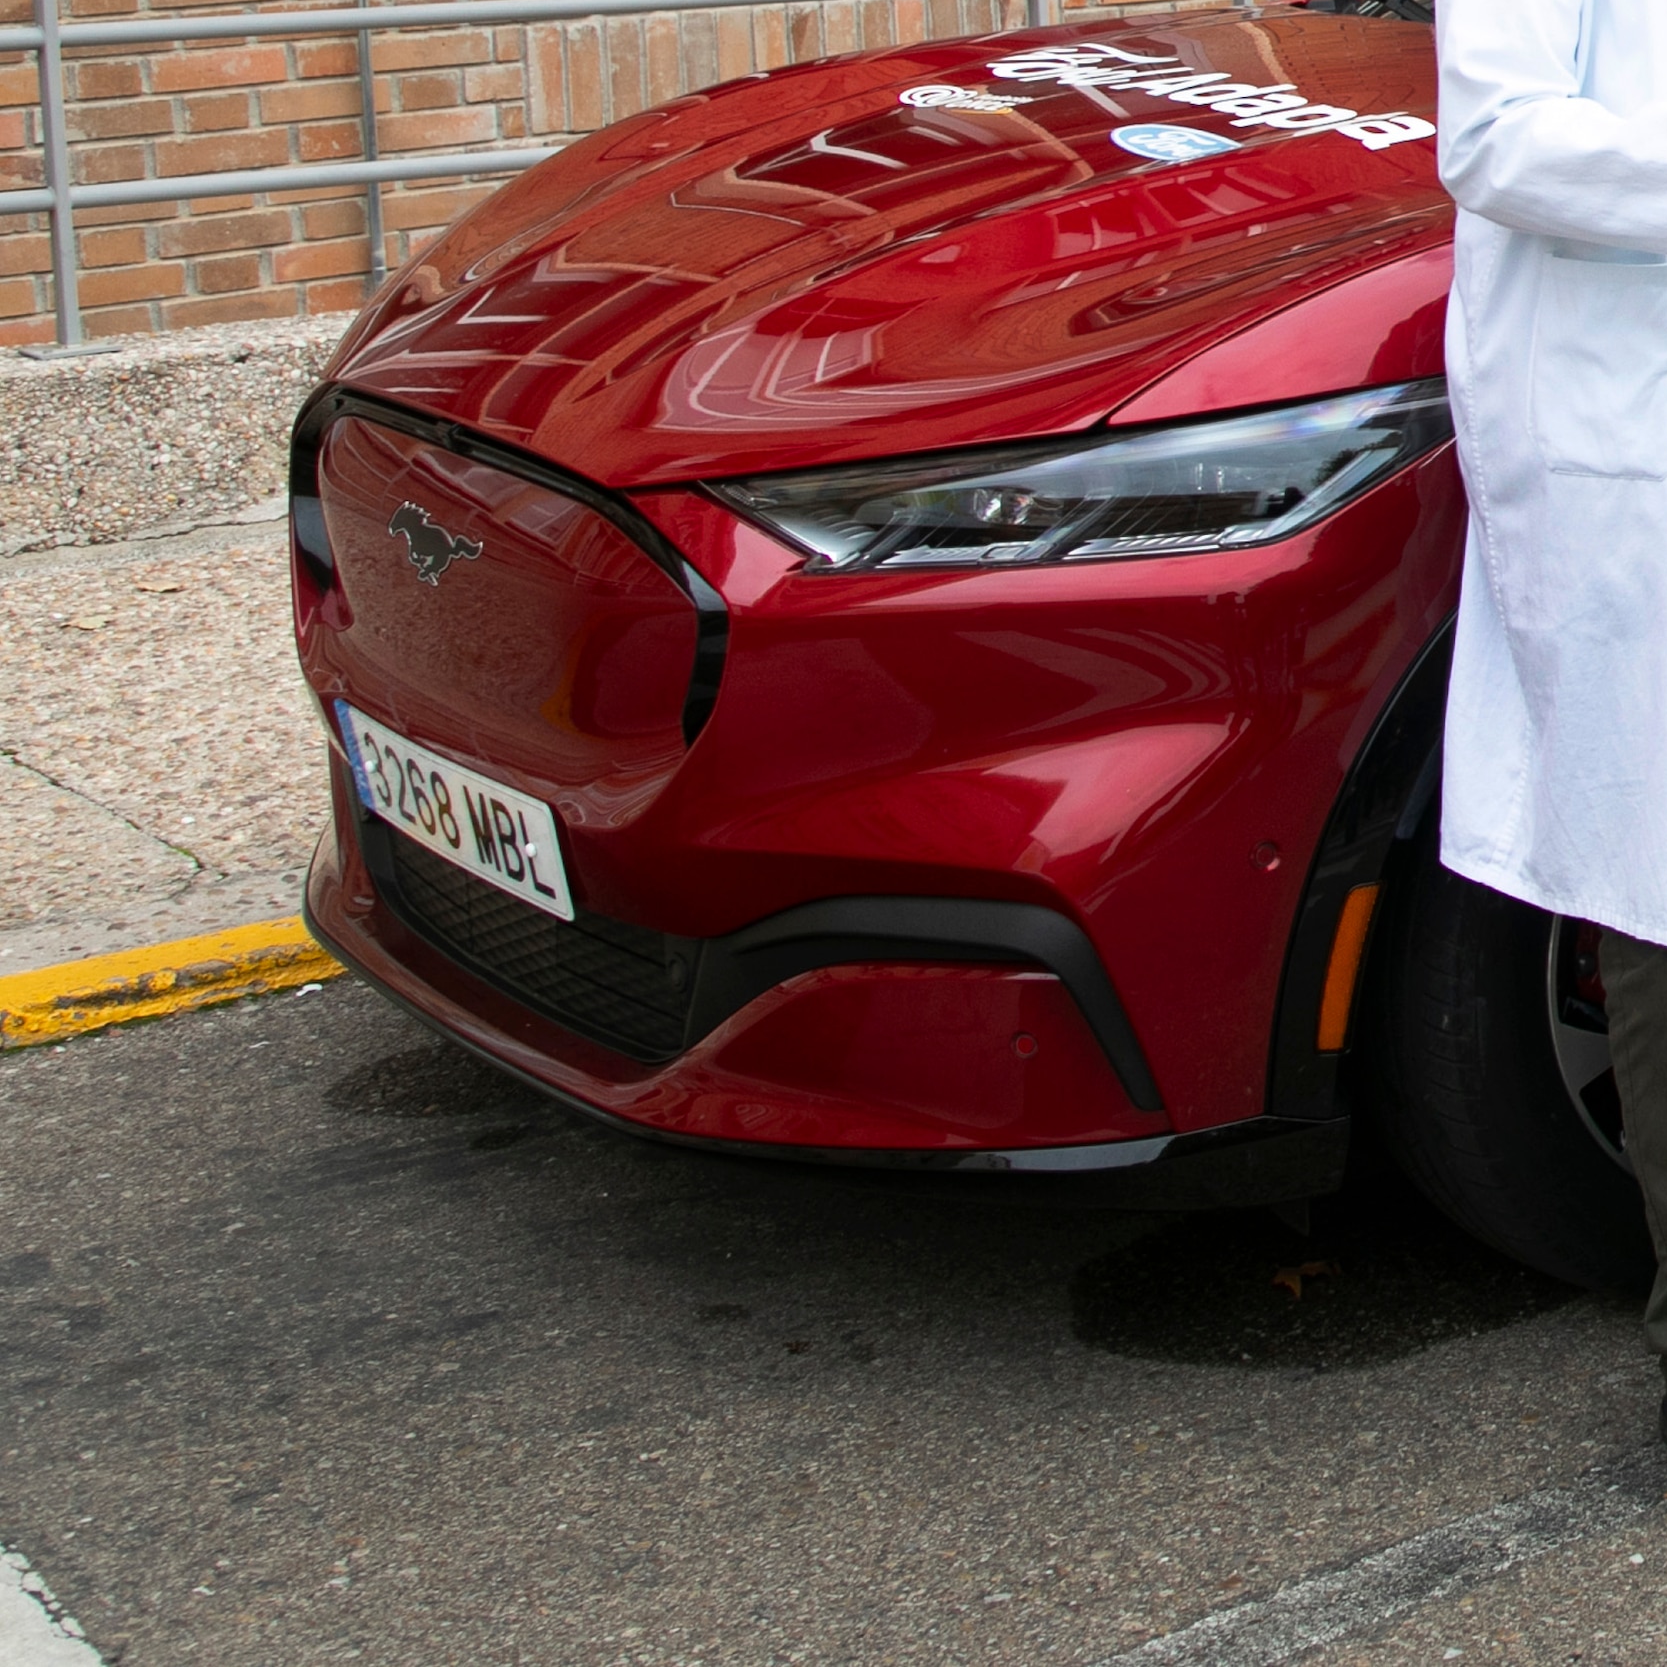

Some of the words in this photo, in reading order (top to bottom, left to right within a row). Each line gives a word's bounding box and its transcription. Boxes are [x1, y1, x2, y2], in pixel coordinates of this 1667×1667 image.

[1108, 72, 1437, 151] Adapta
[363, 731, 461, 850] 3268
[462, 784, 557, 901] MBL
